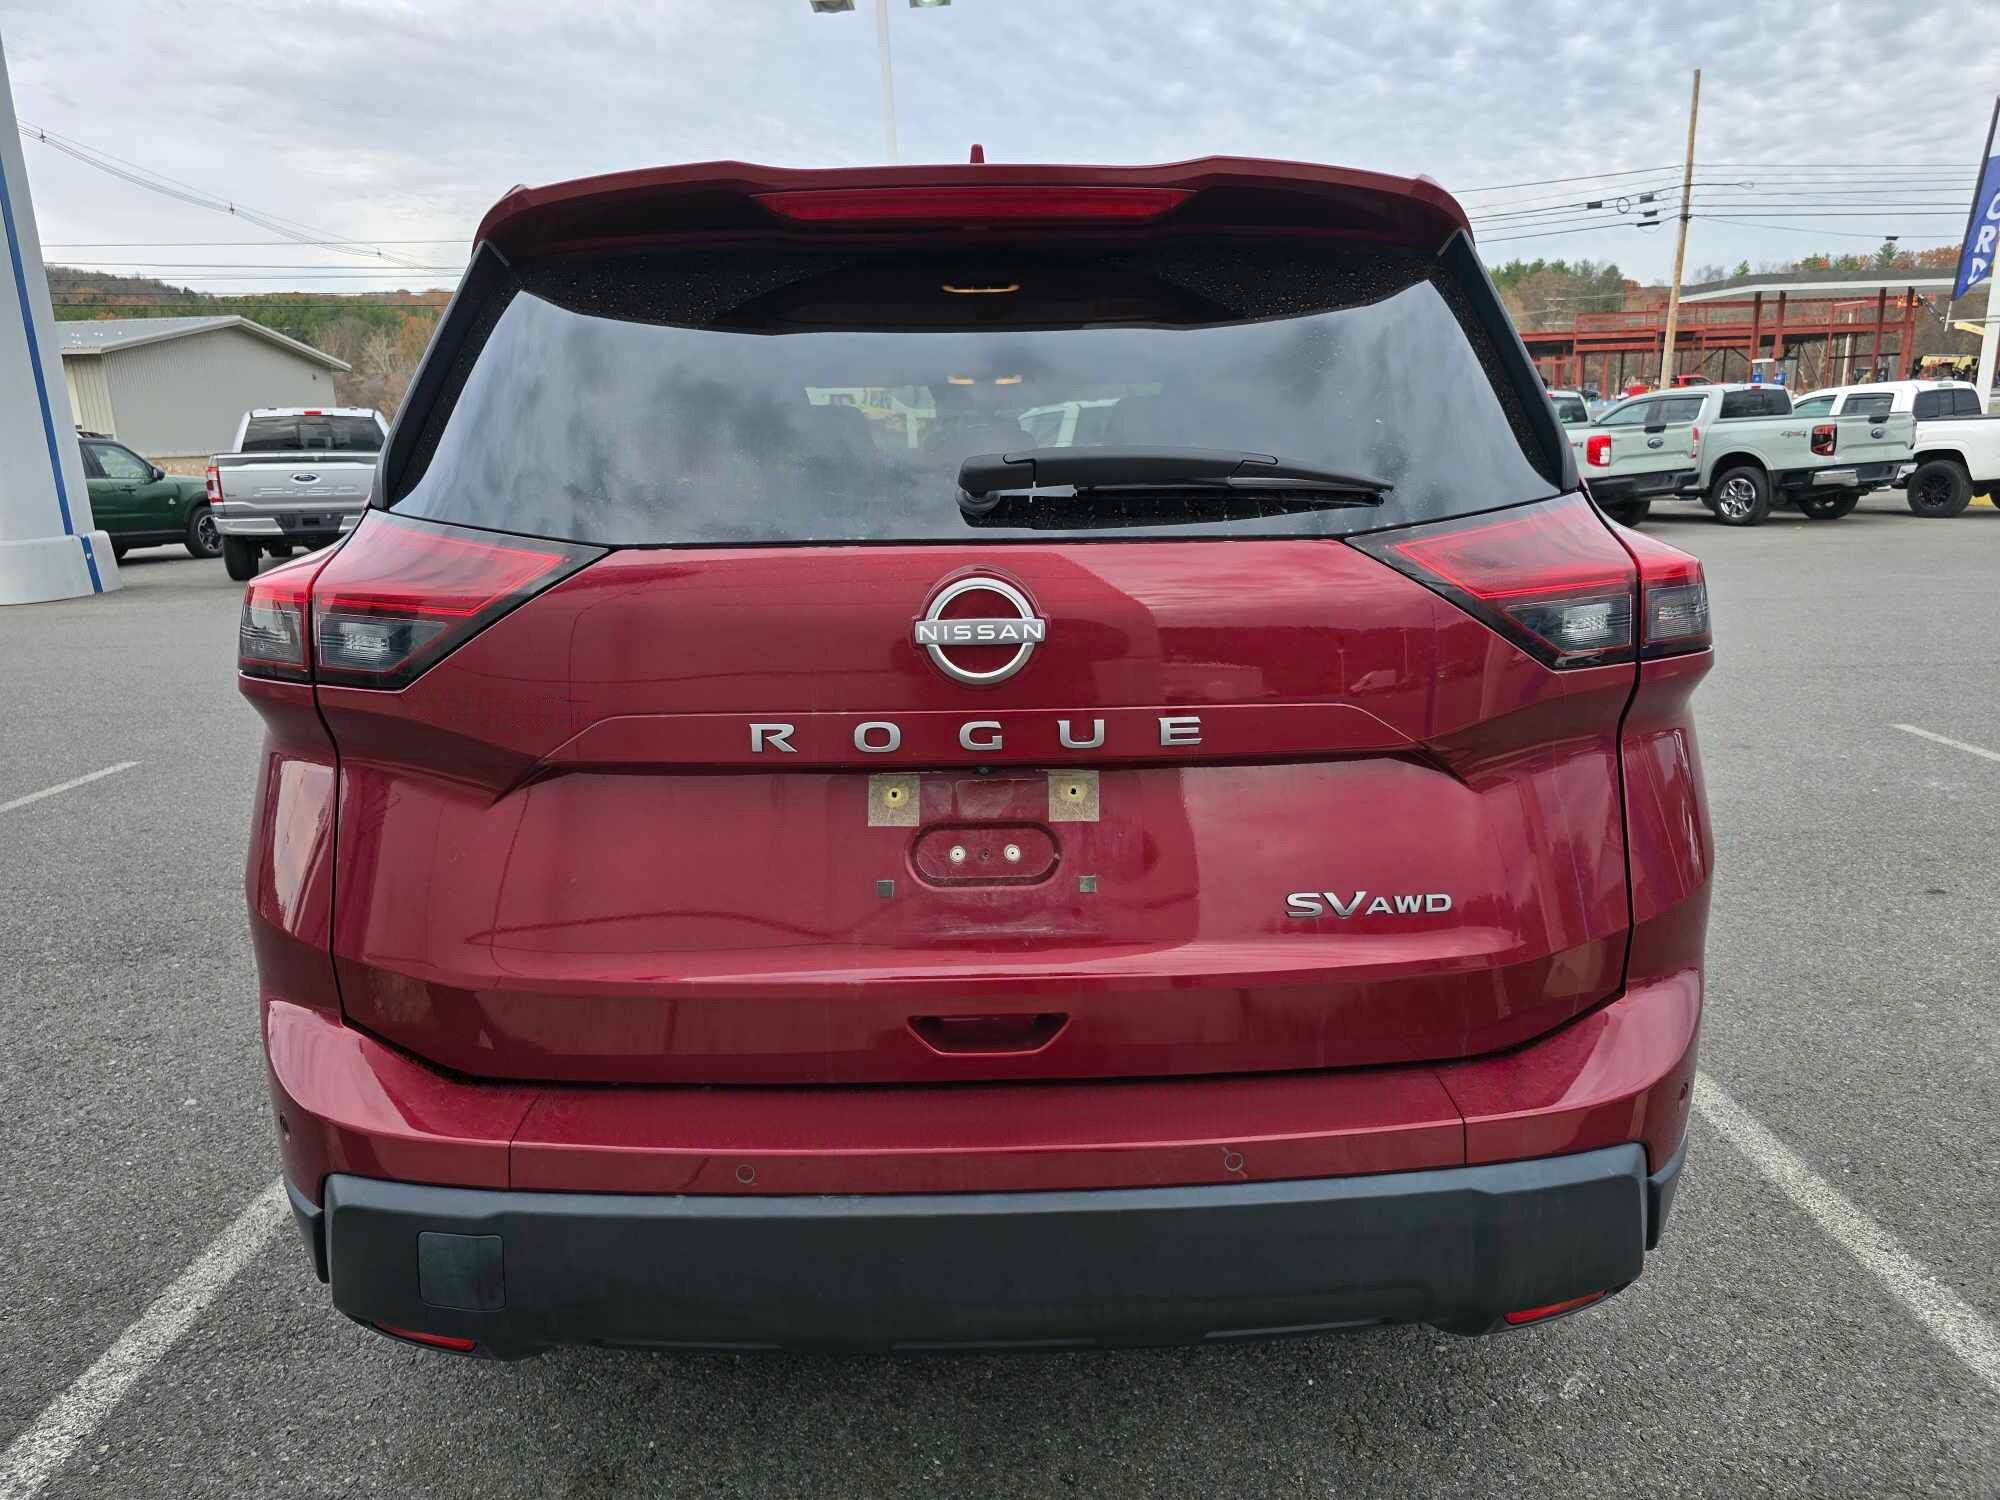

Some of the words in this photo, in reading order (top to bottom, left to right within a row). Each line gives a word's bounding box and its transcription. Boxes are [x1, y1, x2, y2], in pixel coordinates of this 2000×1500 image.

[919, 623, 1042, 641] NISSAN
[749, 716, 1202, 753] ROGUE
[1286, 890, 1367, 919] SV
[1364, 893, 1452, 916] AWD
